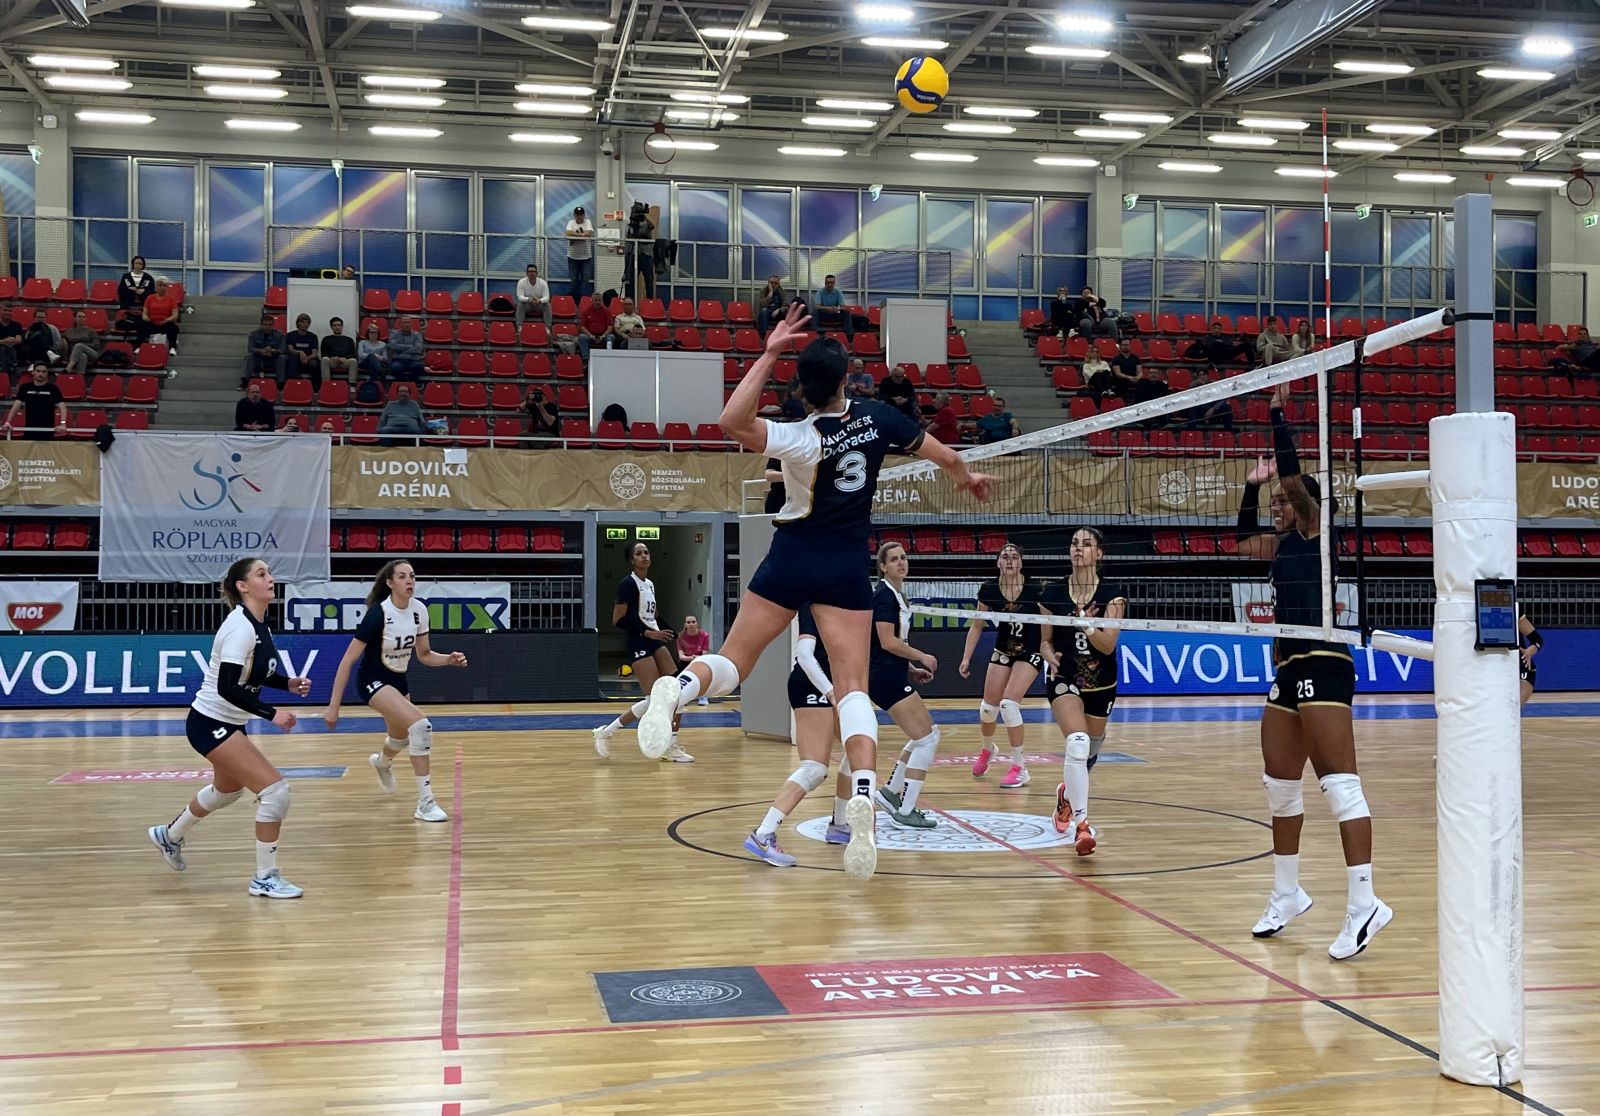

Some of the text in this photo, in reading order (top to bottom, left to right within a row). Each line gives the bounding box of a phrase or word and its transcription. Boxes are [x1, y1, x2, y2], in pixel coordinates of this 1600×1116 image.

[361, 461, 468, 476] LUDOVIKA
[834, 451, 867, 492] 3
[378, 478, 451, 497] ARÉNA
[1566, 492, 1600, 509] ARÉ
[193, 519, 237, 528] MAGYAR
[153, 528, 278, 550] RÖPLABDA
[13, 606, 45, 620] MOL
[1008, 622, 1024, 638] 12
[393, 635, 415, 651] 12
[1074, 631, 1088, 651] 8
[1029, 654, 1042, 666] 12
[366, 681, 383, 694] 12
[1296, 679, 1314, 698] 25
[810, 968, 1101, 989] LUDOVIKA
[822, 984, 1025, 1001] ARÉNA
